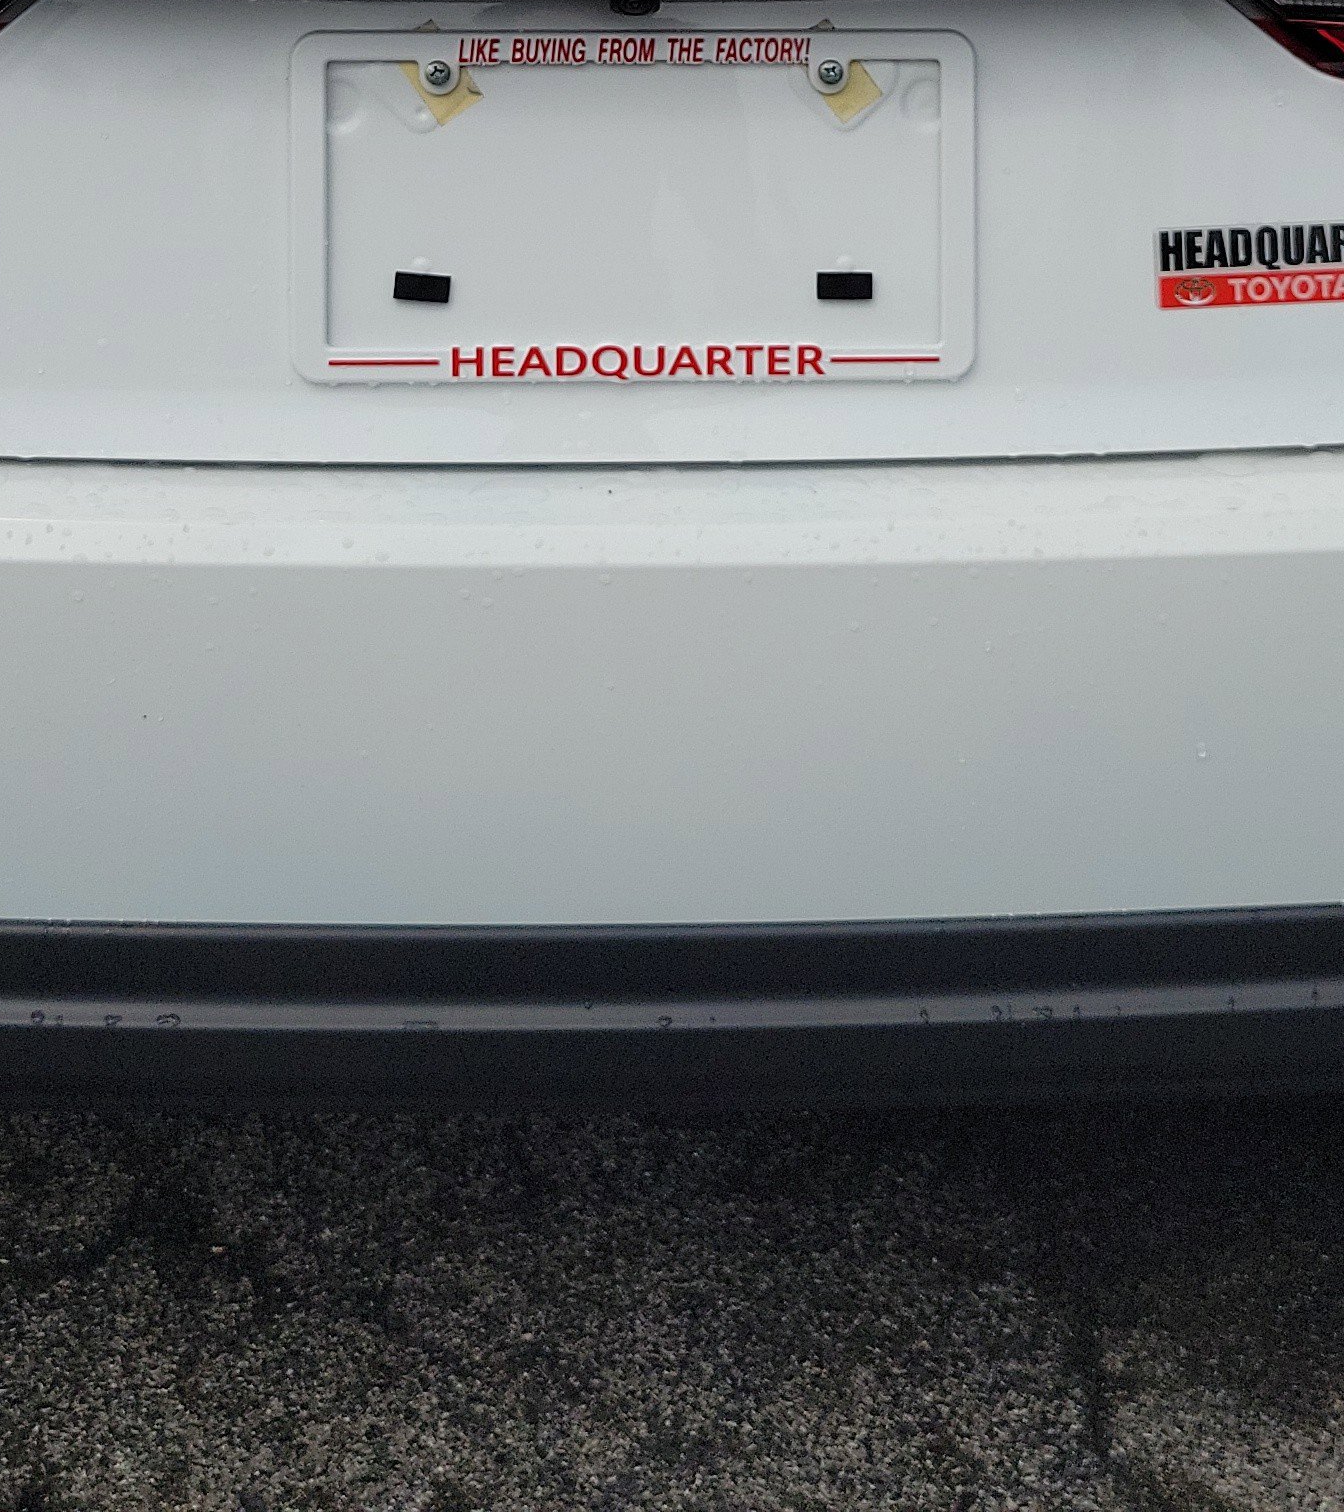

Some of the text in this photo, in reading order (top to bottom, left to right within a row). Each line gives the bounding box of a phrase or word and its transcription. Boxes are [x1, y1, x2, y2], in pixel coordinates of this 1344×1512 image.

[458, 37, 811, 64] LIKE BUYING FROM THE FACTORY!
[452, 344, 826, 381] HEADQUARTER
